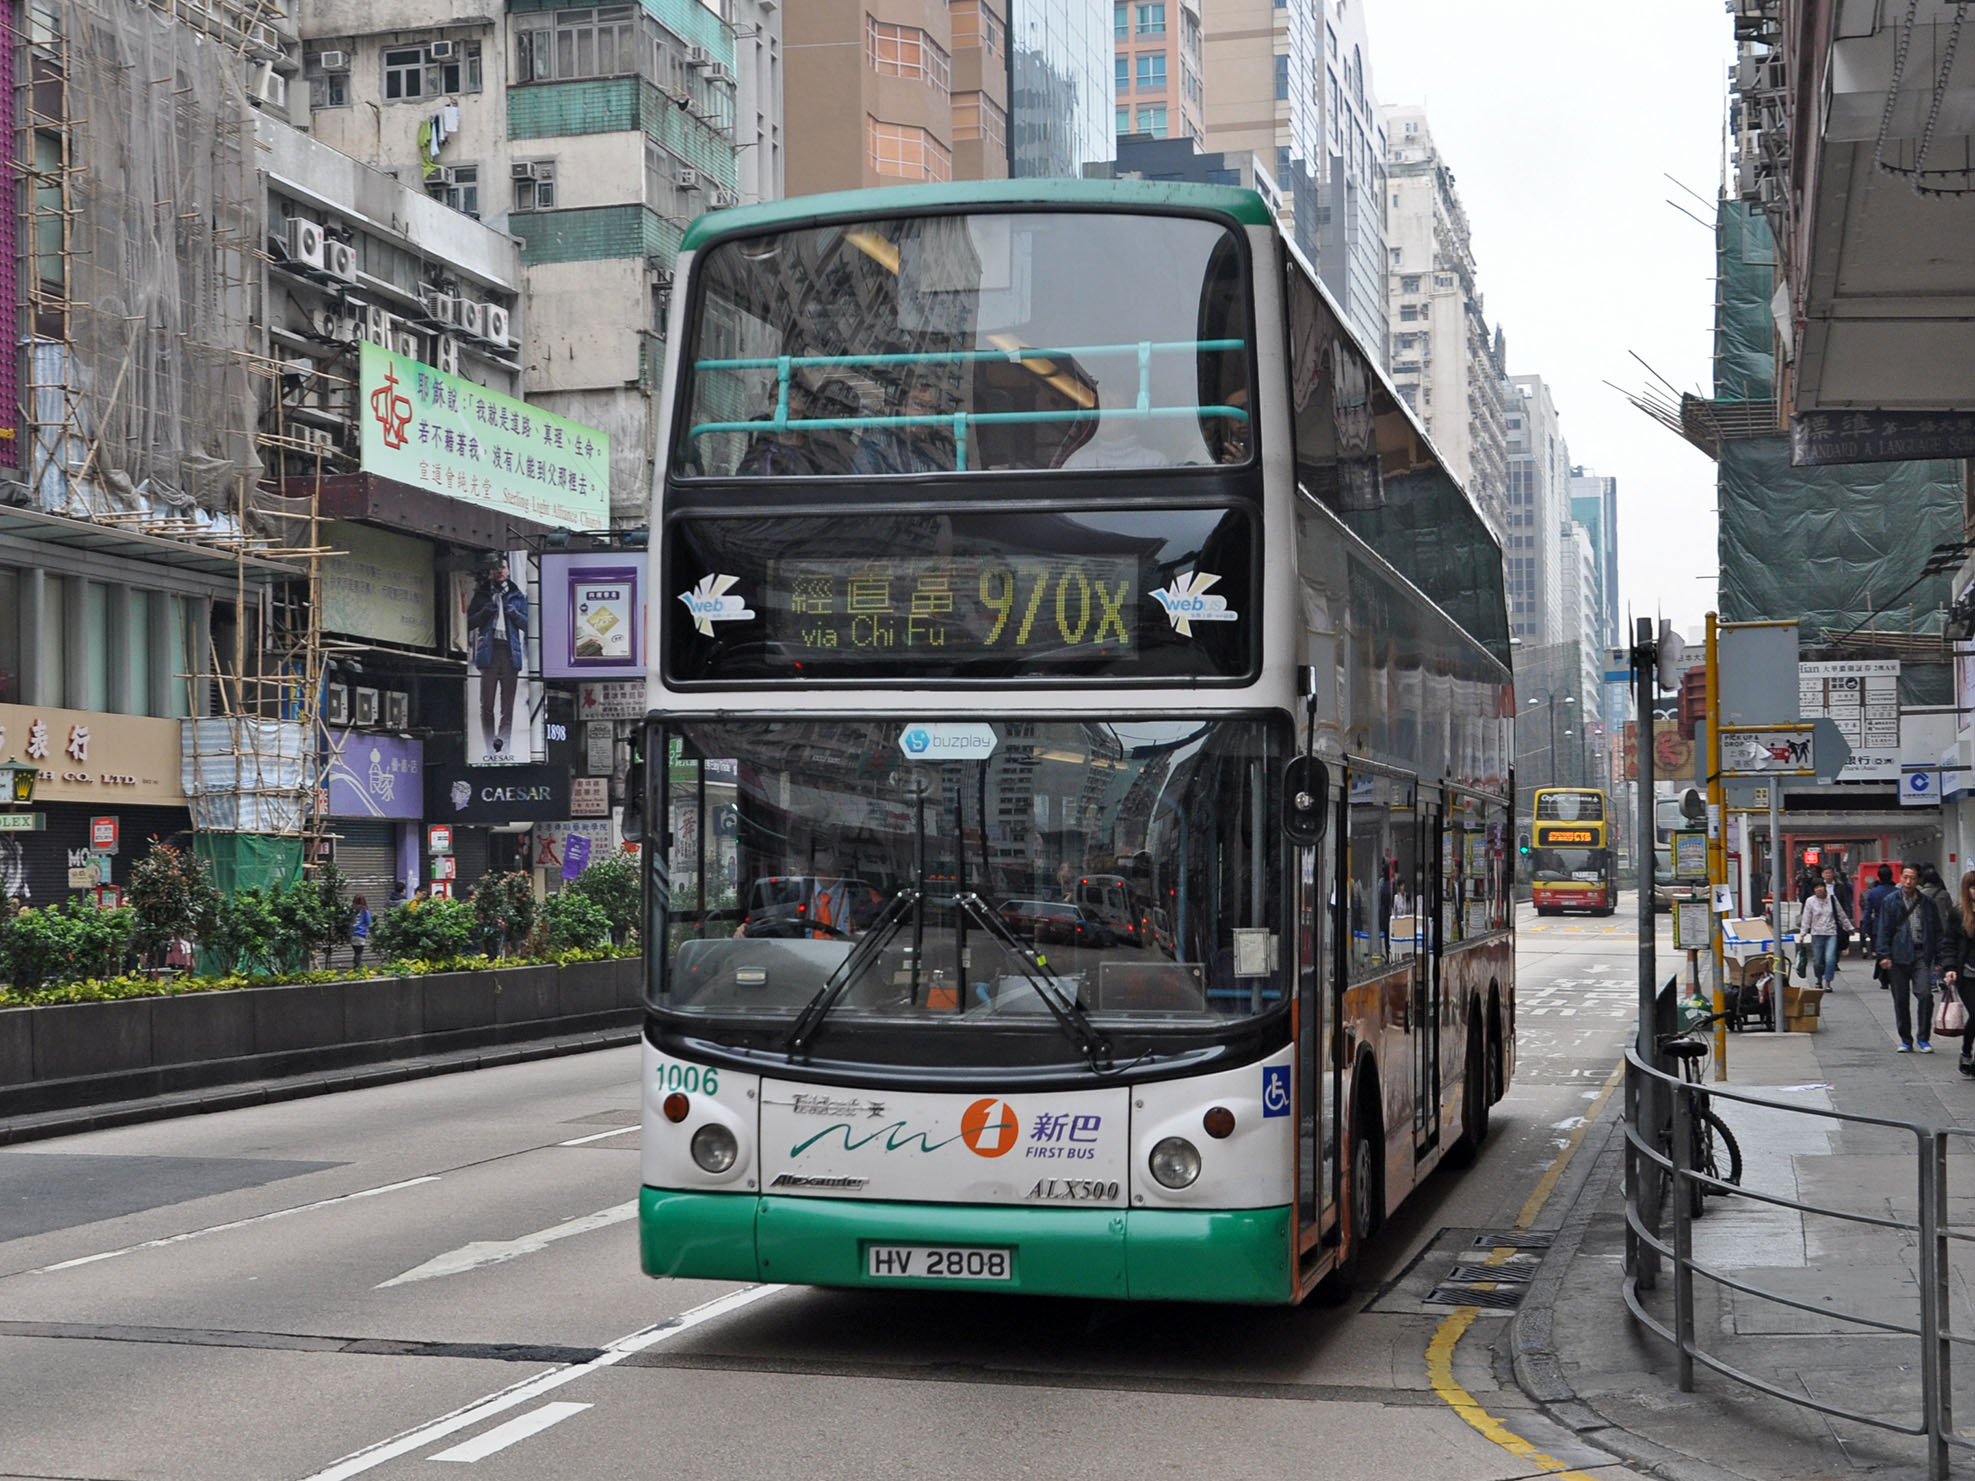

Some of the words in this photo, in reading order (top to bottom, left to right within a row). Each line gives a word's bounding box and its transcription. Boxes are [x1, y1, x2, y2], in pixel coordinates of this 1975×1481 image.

[801, 620, 838, 647] via
[851, 615, 894, 647] Chi
[908, 614, 945, 646] Fu
[546, 723, 567, 742] 1898
[933, 734, 991, 749] buzplay
[482, 754, 515, 762] CAESAR
[481, 786, 551, 802] CAESAR
[657, 1064, 719, 1096] 1006
[1030, 1113, 1102, 1143] 新巴
[1026, 1146, 1065, 1159] FIRST
[1067, 1147, 1096, 1160] BUS
[771, 1174, 868, 1188] Alexander
[1025, 1177, 1121, 1201] ALX500
[875, 1250, 912, 1274] HV
[926, 1251, 1006, 1276] 2808
